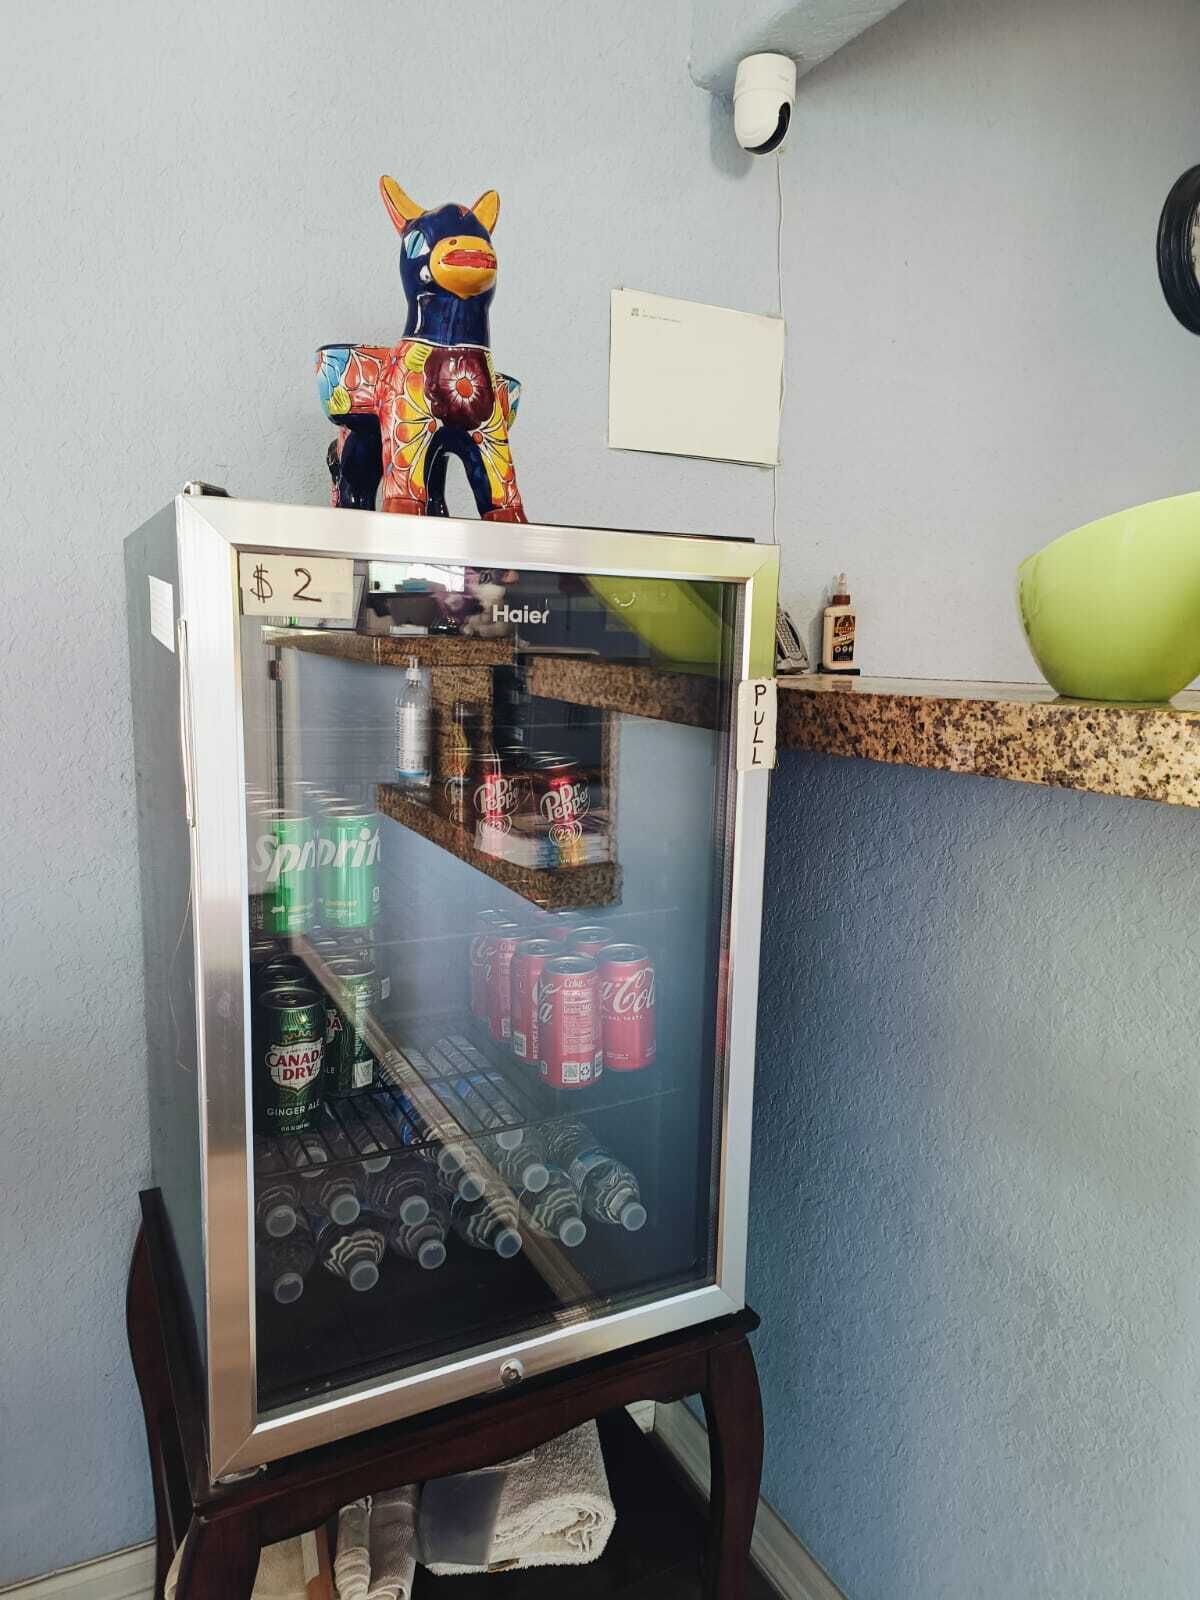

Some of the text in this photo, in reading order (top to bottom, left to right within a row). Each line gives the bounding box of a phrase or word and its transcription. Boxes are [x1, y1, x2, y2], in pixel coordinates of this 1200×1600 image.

[493, 605, 550, 624] Haier
[752, 684, 767, 765] PULL
[496, 778, 514, 795] Dr
[560, 783, 581, 803] Dr
[475, 784, 519, 815] Peppe
[265, 1048, 323, 1069] CANAD
[282, 1064, 315, 1081] DRY
[266, 1105, 305, 1117] GINGER
